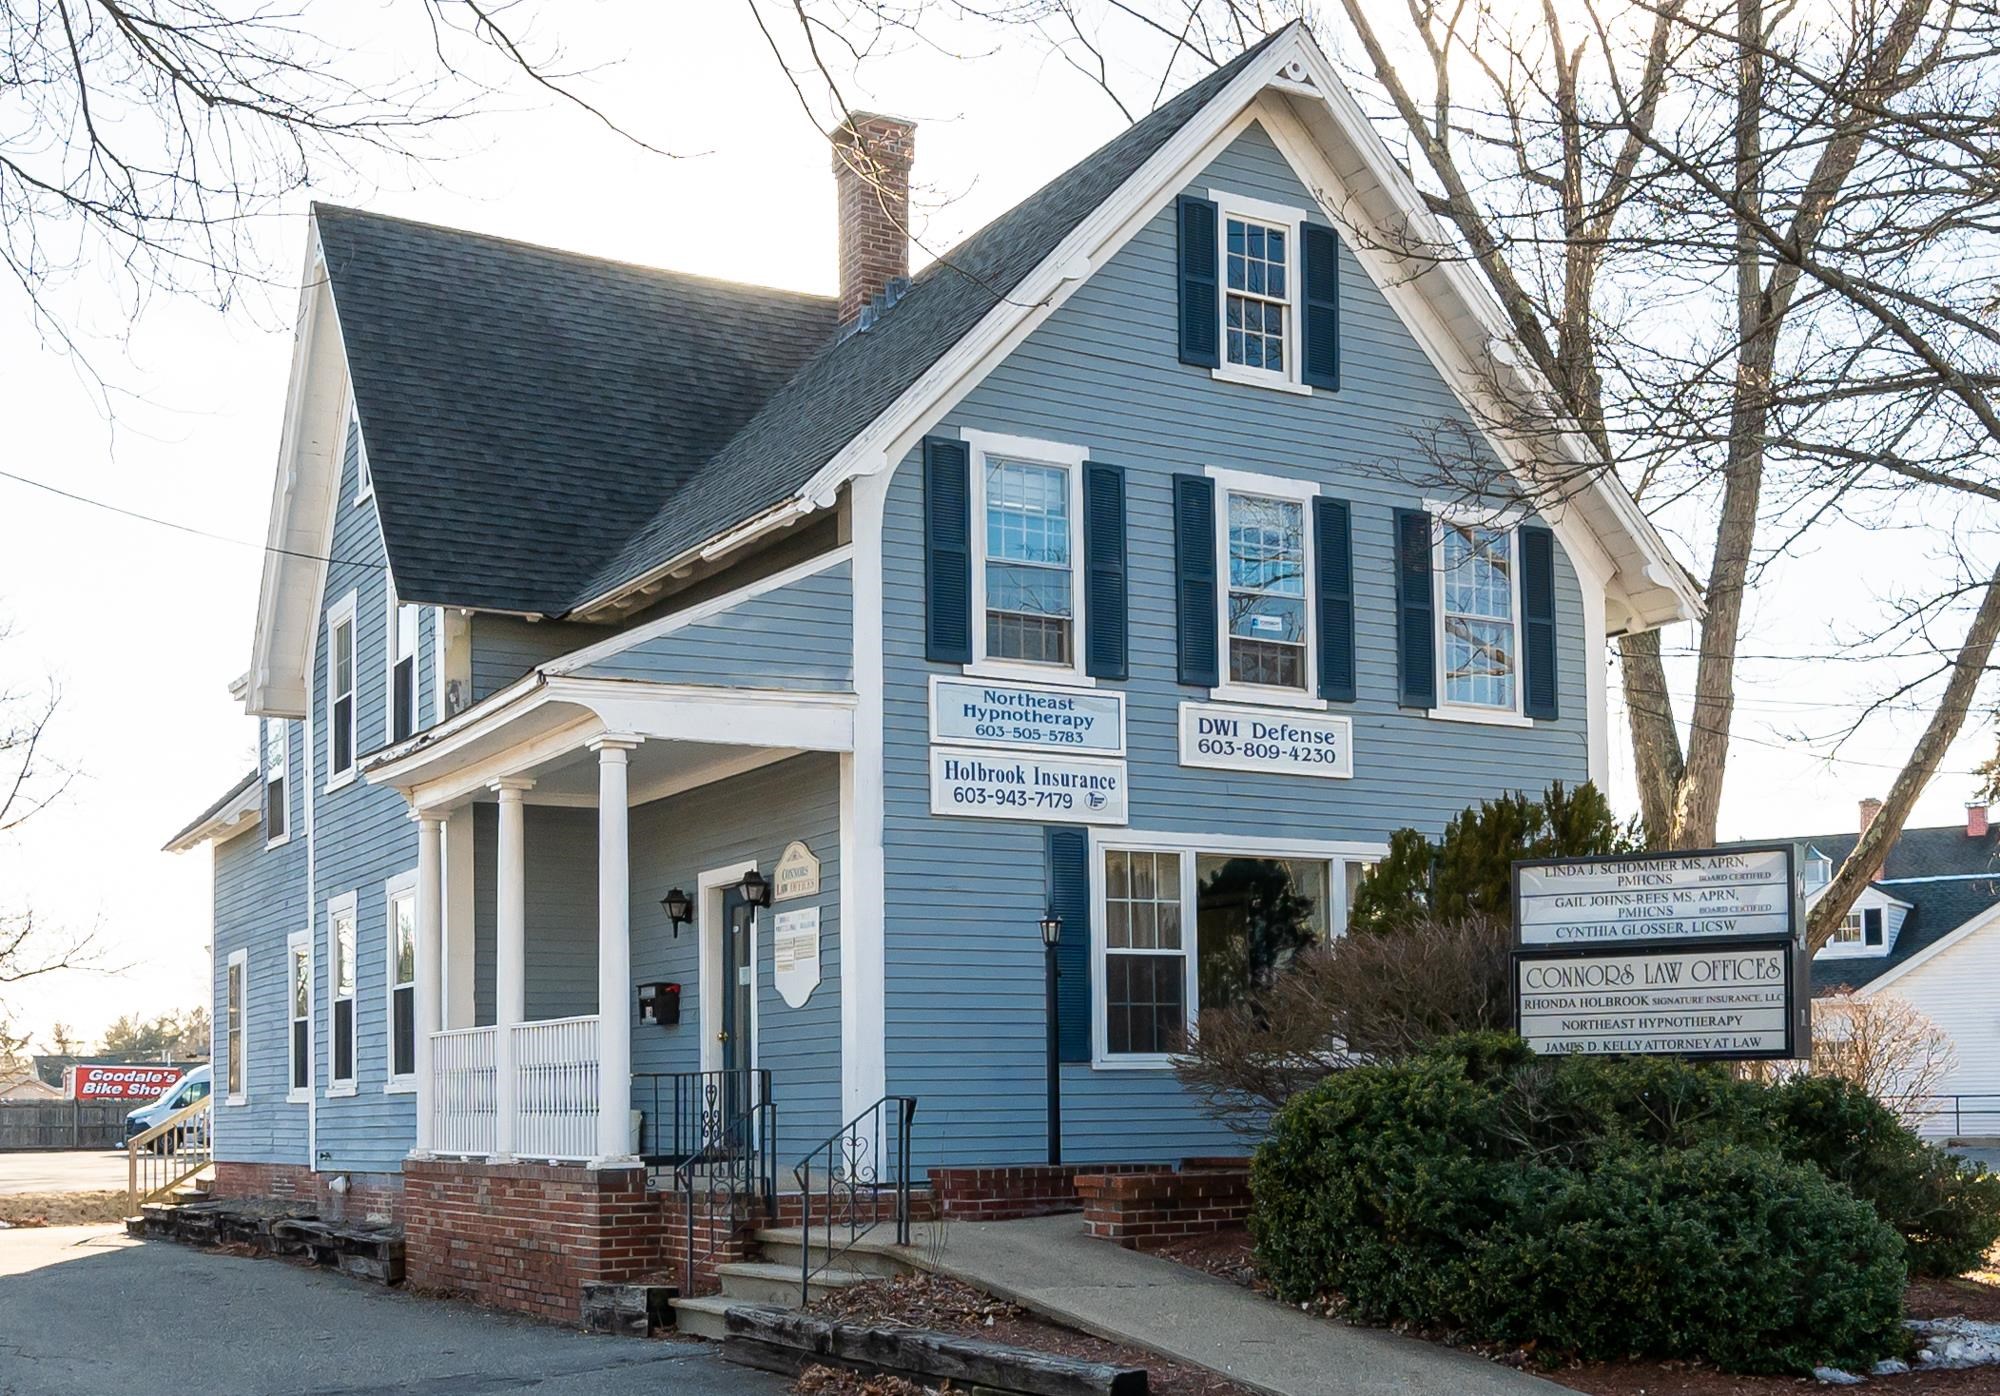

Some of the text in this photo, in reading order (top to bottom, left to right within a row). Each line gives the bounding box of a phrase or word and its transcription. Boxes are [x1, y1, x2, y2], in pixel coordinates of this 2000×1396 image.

[983, 689, 1075, 711] Northeast
[963, 703, 1094, 731] Hypnotherapy
[975, 724, 1084, 744] 603-505-5783
[1198, 717, 1335, 746] DWI Defense
[1198, 738, 1336, 764] 603-809-4230
[944, 759, 1117, 790] Holbrook Insurance
[953, 786, 1073, 809] 603-943-7179
[1544, 864, 1585, 878] LINDA
[1588, 864, 1598, 876] J.
[1600, 860, 1678, 875] SCHOMMER
[1707, 856, 1749, 869] APRN,
[1617, 871, 1772, 887] PMHCNS BOARD CERTIFIED
[1554, 896, 1587, 908] GAIL
[1589, 892, 1669, 907] JOHNS-REES
[1698, 888, 1739, 901] APRN,
[1618, 903, 1772, 918] PMHCNS BOARD CERTIFIED
[1555, 919, 1737, 939] CYNTHIA GLOSSER, LICSW
[1526, 957, 1781, 989] CONNORS LAW OFFICES
[1524, 998, 1577, 1010] RHONDA
[1580, 995, 1649, 1008] HOLBROOK
[1652, 995, 1703, 1006] SIGNATURE
[1765, 993, 1784, 1002] LLC
[1561, 1015, 1743, 1031] NORTHEAST HYPNOTHERAPY
[1545, 1037, 1762, 1053] JAMES D. KELLY ATTORNEY AT LAW
[88, 1069, 177, 1083] Goodale's
[82, 1082, 123, 1095] Bike
